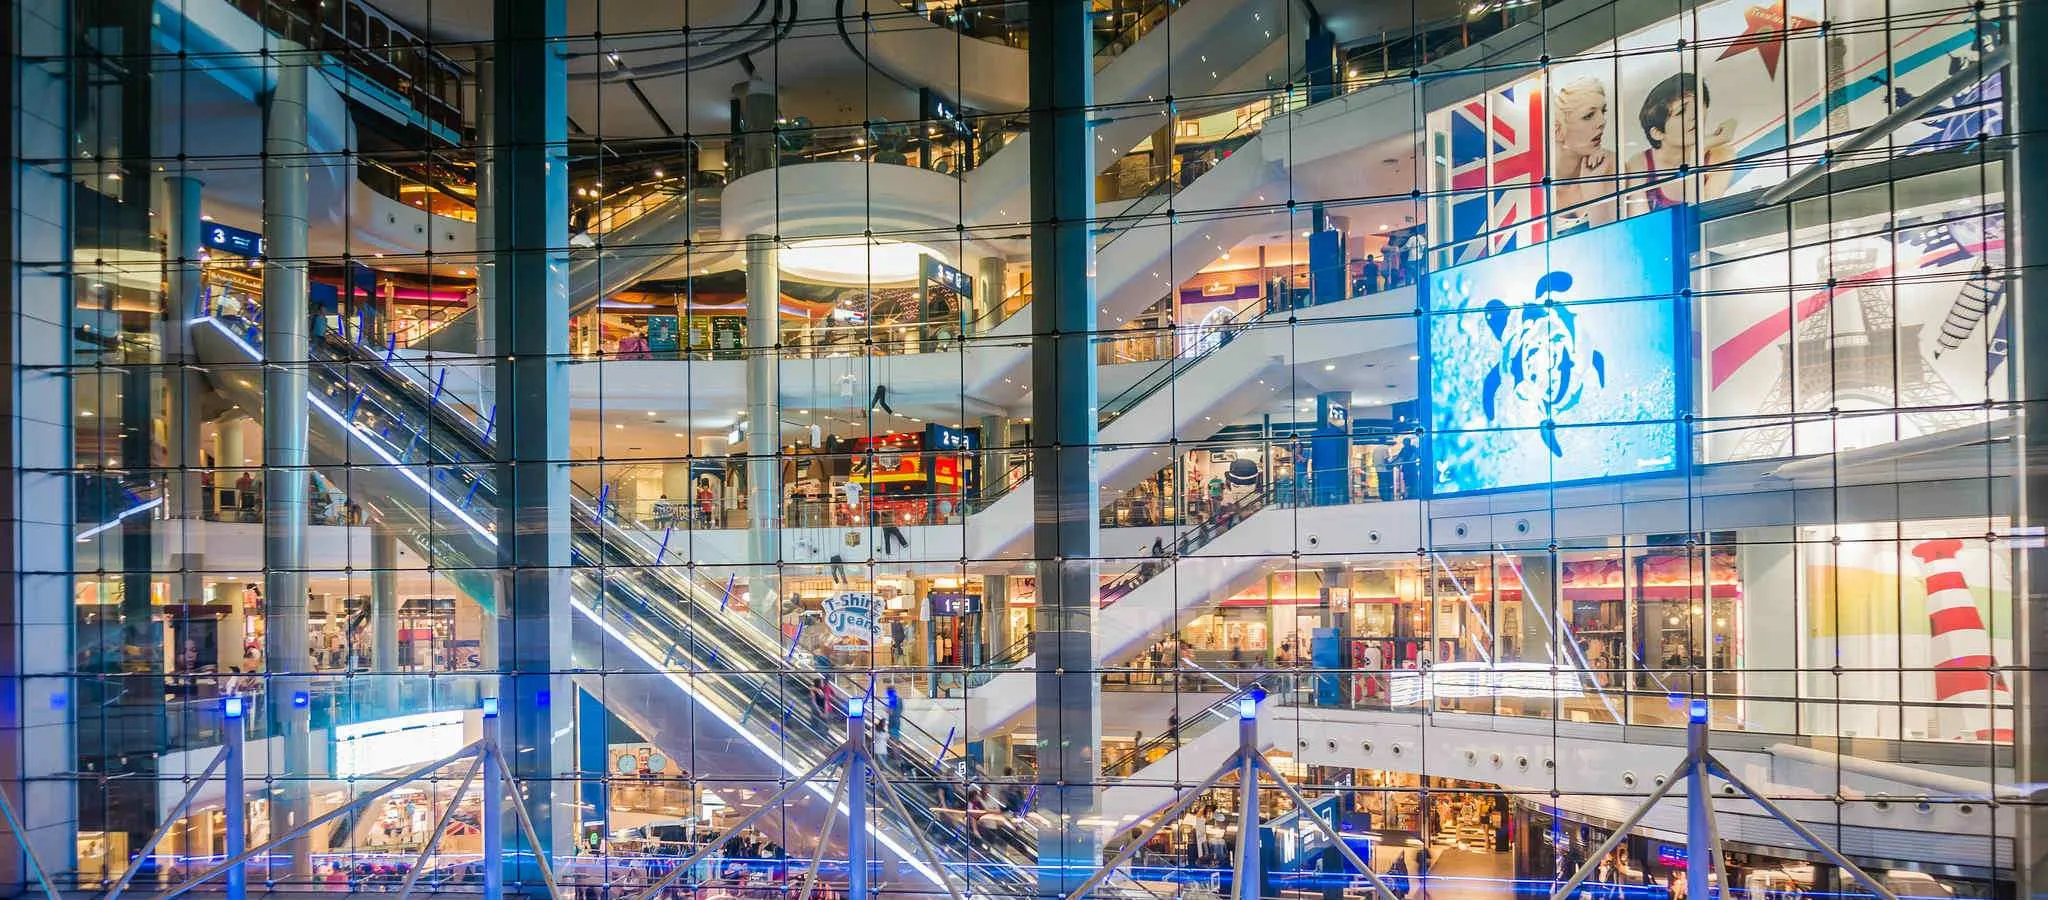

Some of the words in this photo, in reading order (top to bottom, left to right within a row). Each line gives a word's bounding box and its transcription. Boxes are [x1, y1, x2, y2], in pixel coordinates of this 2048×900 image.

[213, 228, 225, 244] 3
[943, 431, 950, 446] 2
[945, 599, 951, 613] 1
